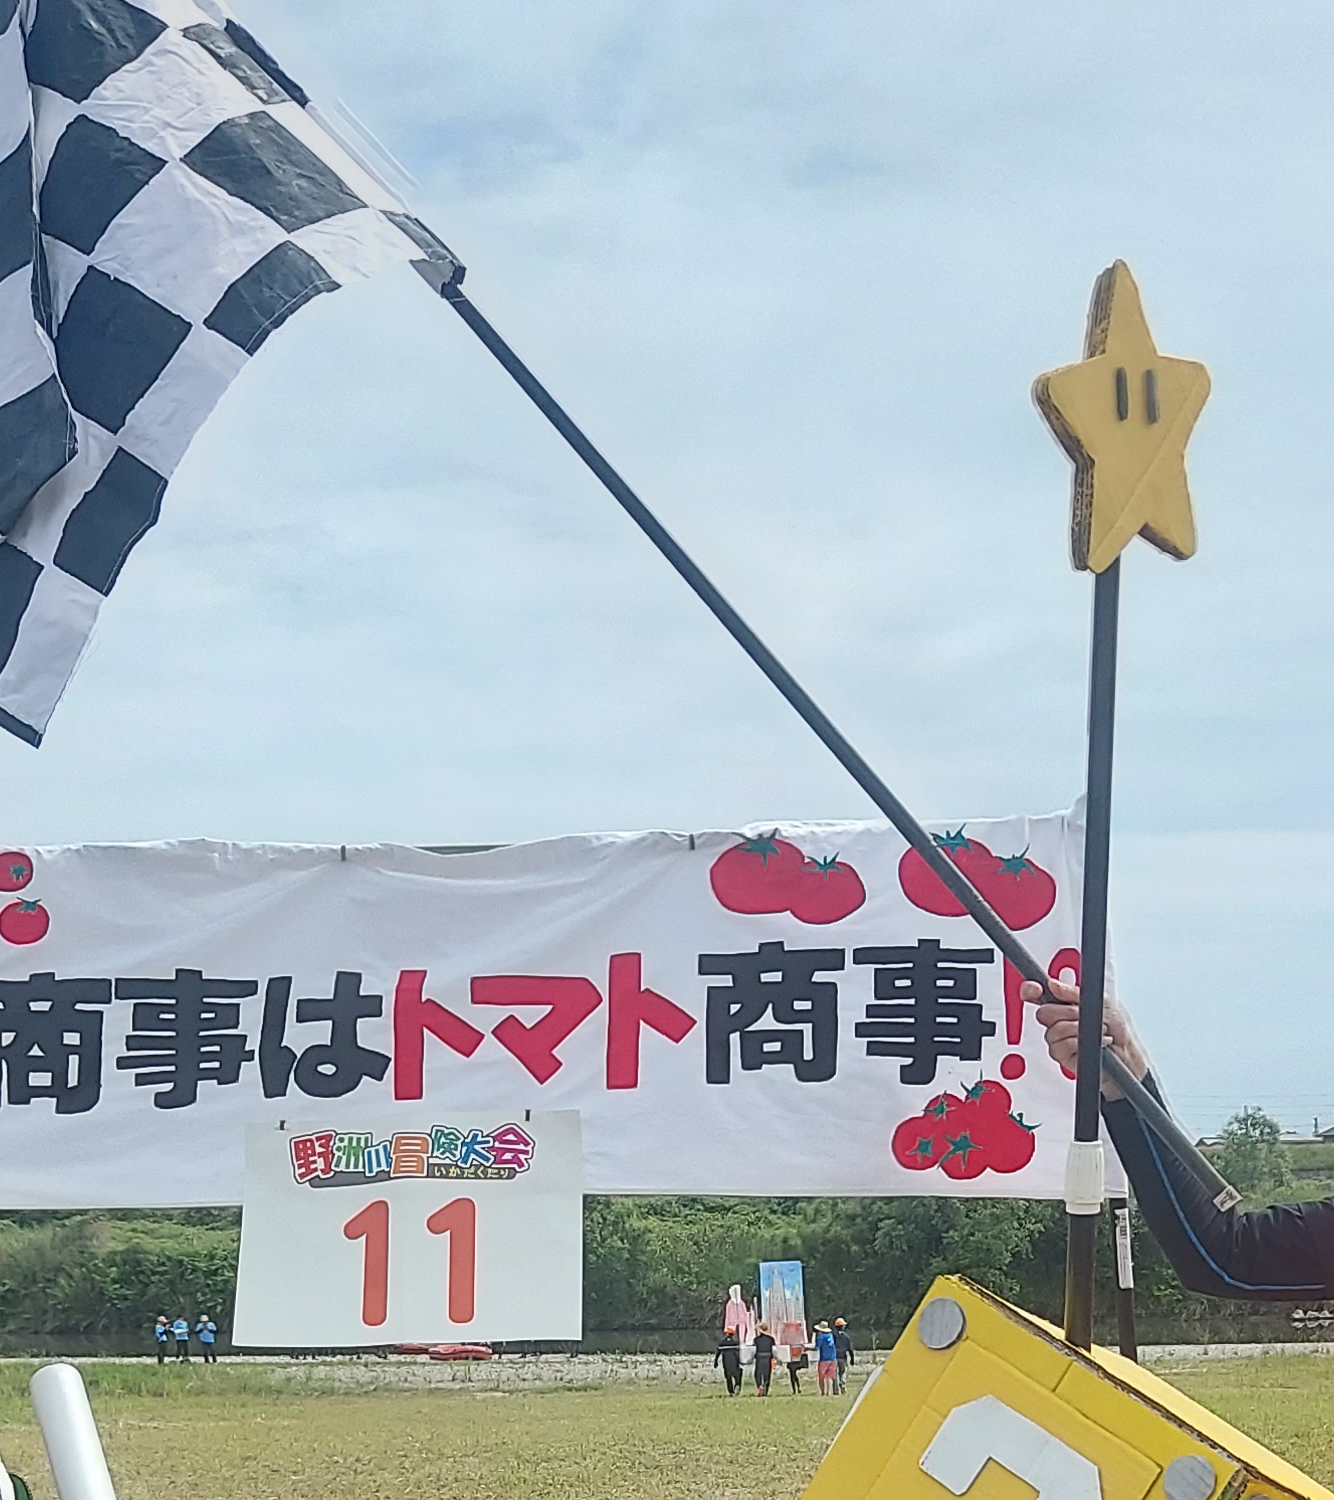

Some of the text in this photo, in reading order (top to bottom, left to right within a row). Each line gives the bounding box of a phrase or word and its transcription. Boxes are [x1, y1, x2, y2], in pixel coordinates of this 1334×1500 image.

[291, 1124, 534, 1182] 野洲川冒険大会
[343, 1197, 476, 1327] 11
